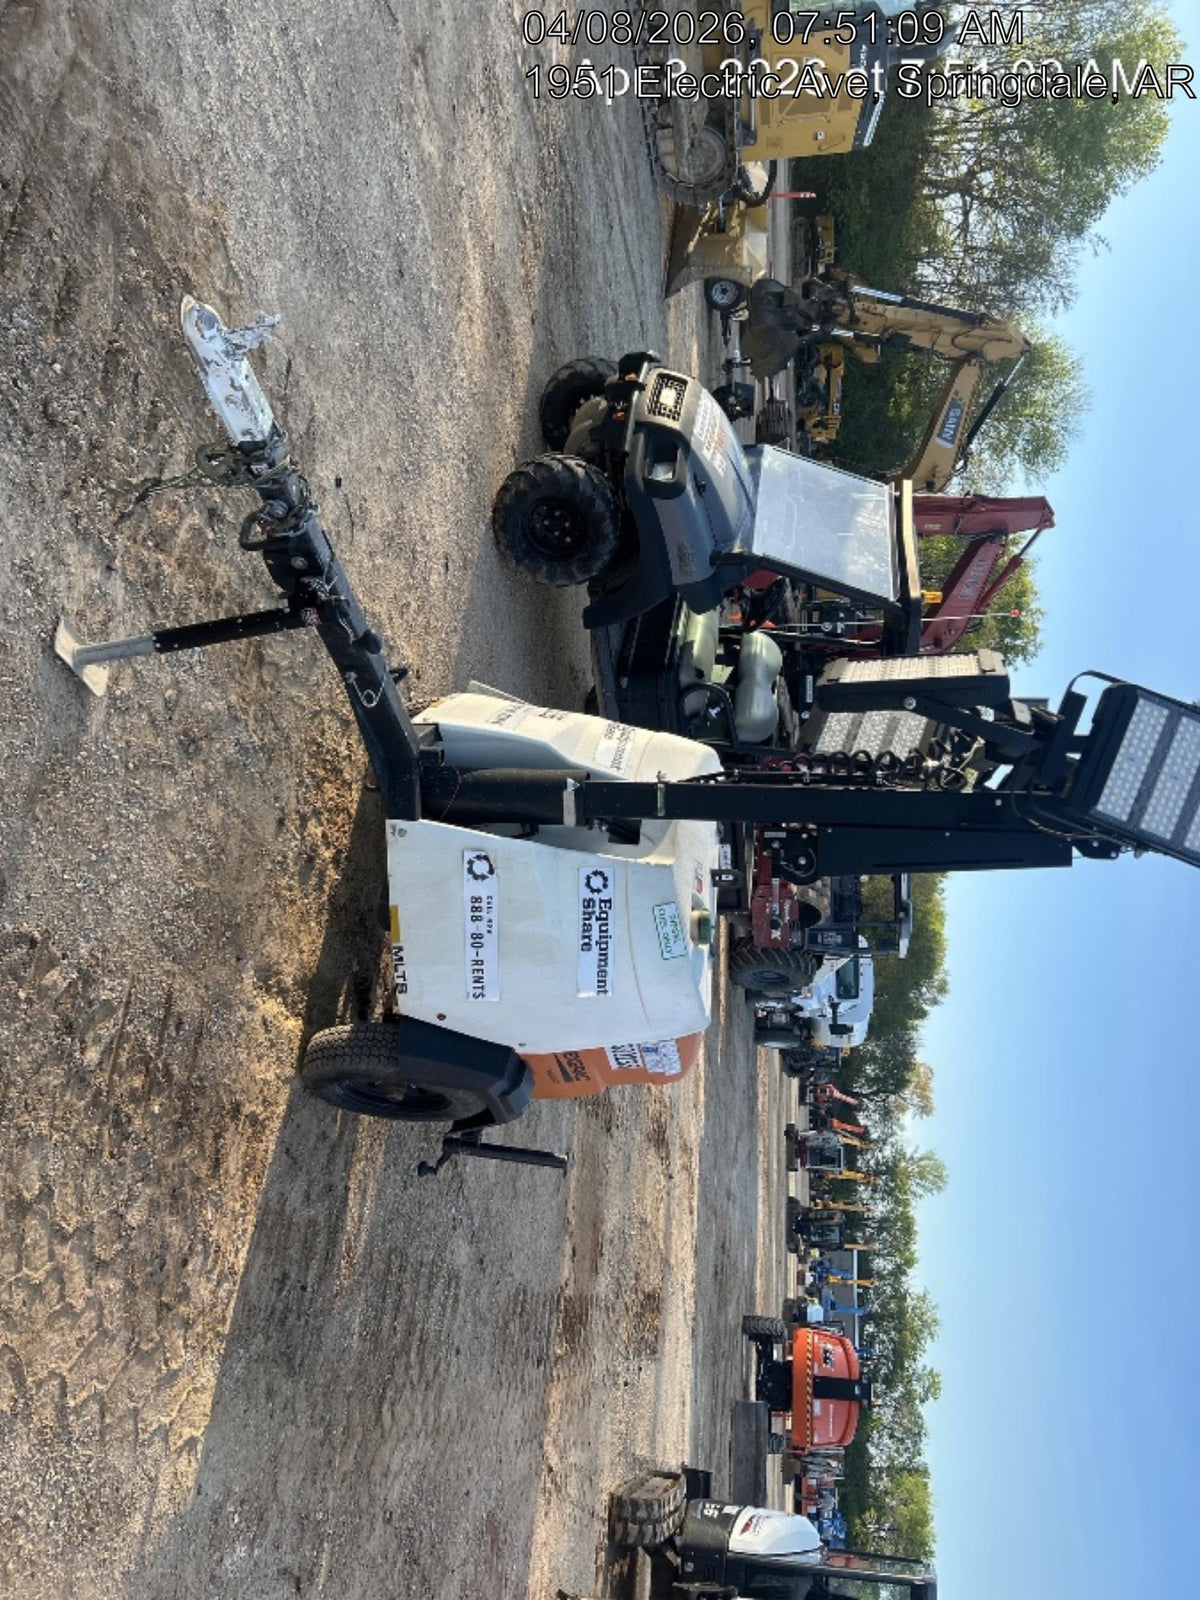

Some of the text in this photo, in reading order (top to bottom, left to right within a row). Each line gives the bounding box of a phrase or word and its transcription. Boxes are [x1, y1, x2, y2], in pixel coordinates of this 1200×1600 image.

[470, 896, 485, 1000] 888-80-RENTS
[581, 898, 596, 952] Share
[595, 898, 612, 996] Equipment
